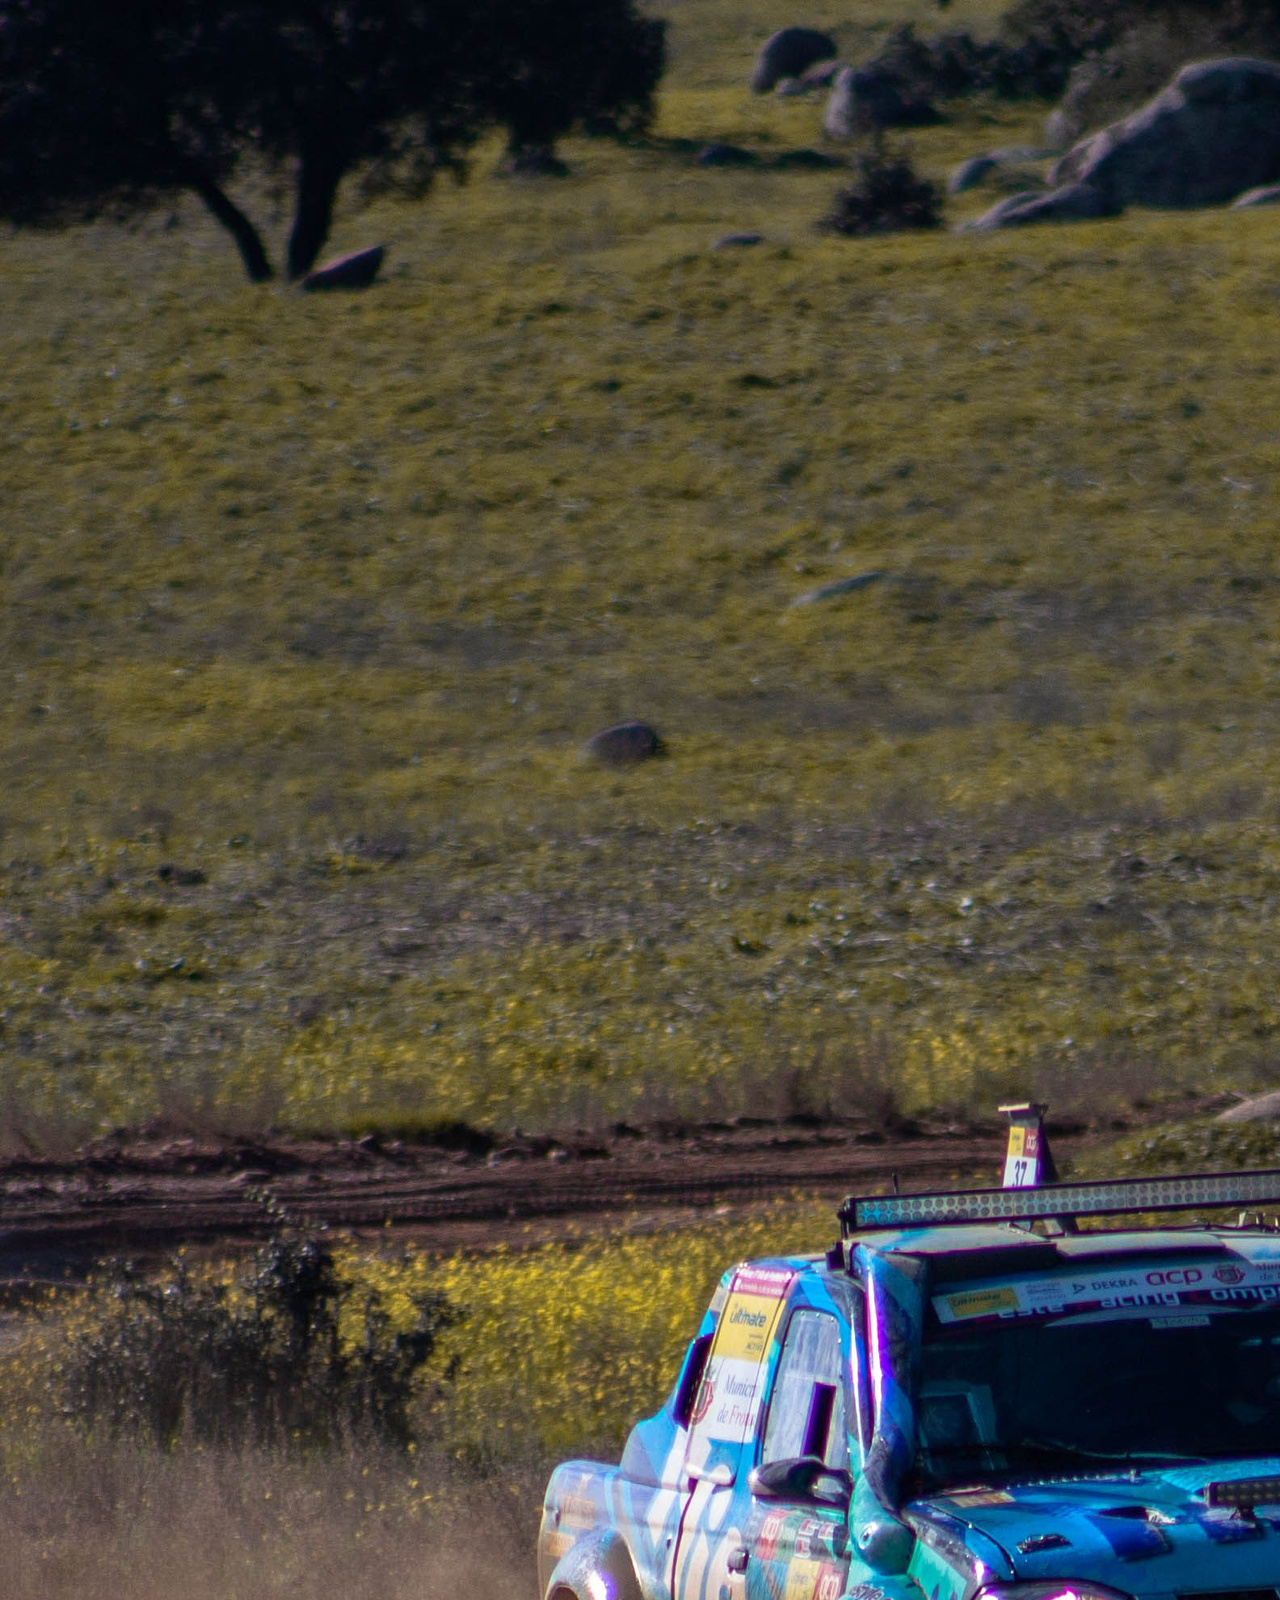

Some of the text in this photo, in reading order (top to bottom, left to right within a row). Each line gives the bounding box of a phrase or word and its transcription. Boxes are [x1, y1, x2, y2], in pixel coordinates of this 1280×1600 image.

[1012, 1160, 1028, 1187] 37
[1091, 1279, 1138, 1294] DEKRA
[1146, 1266, 1203, 1288] acp
